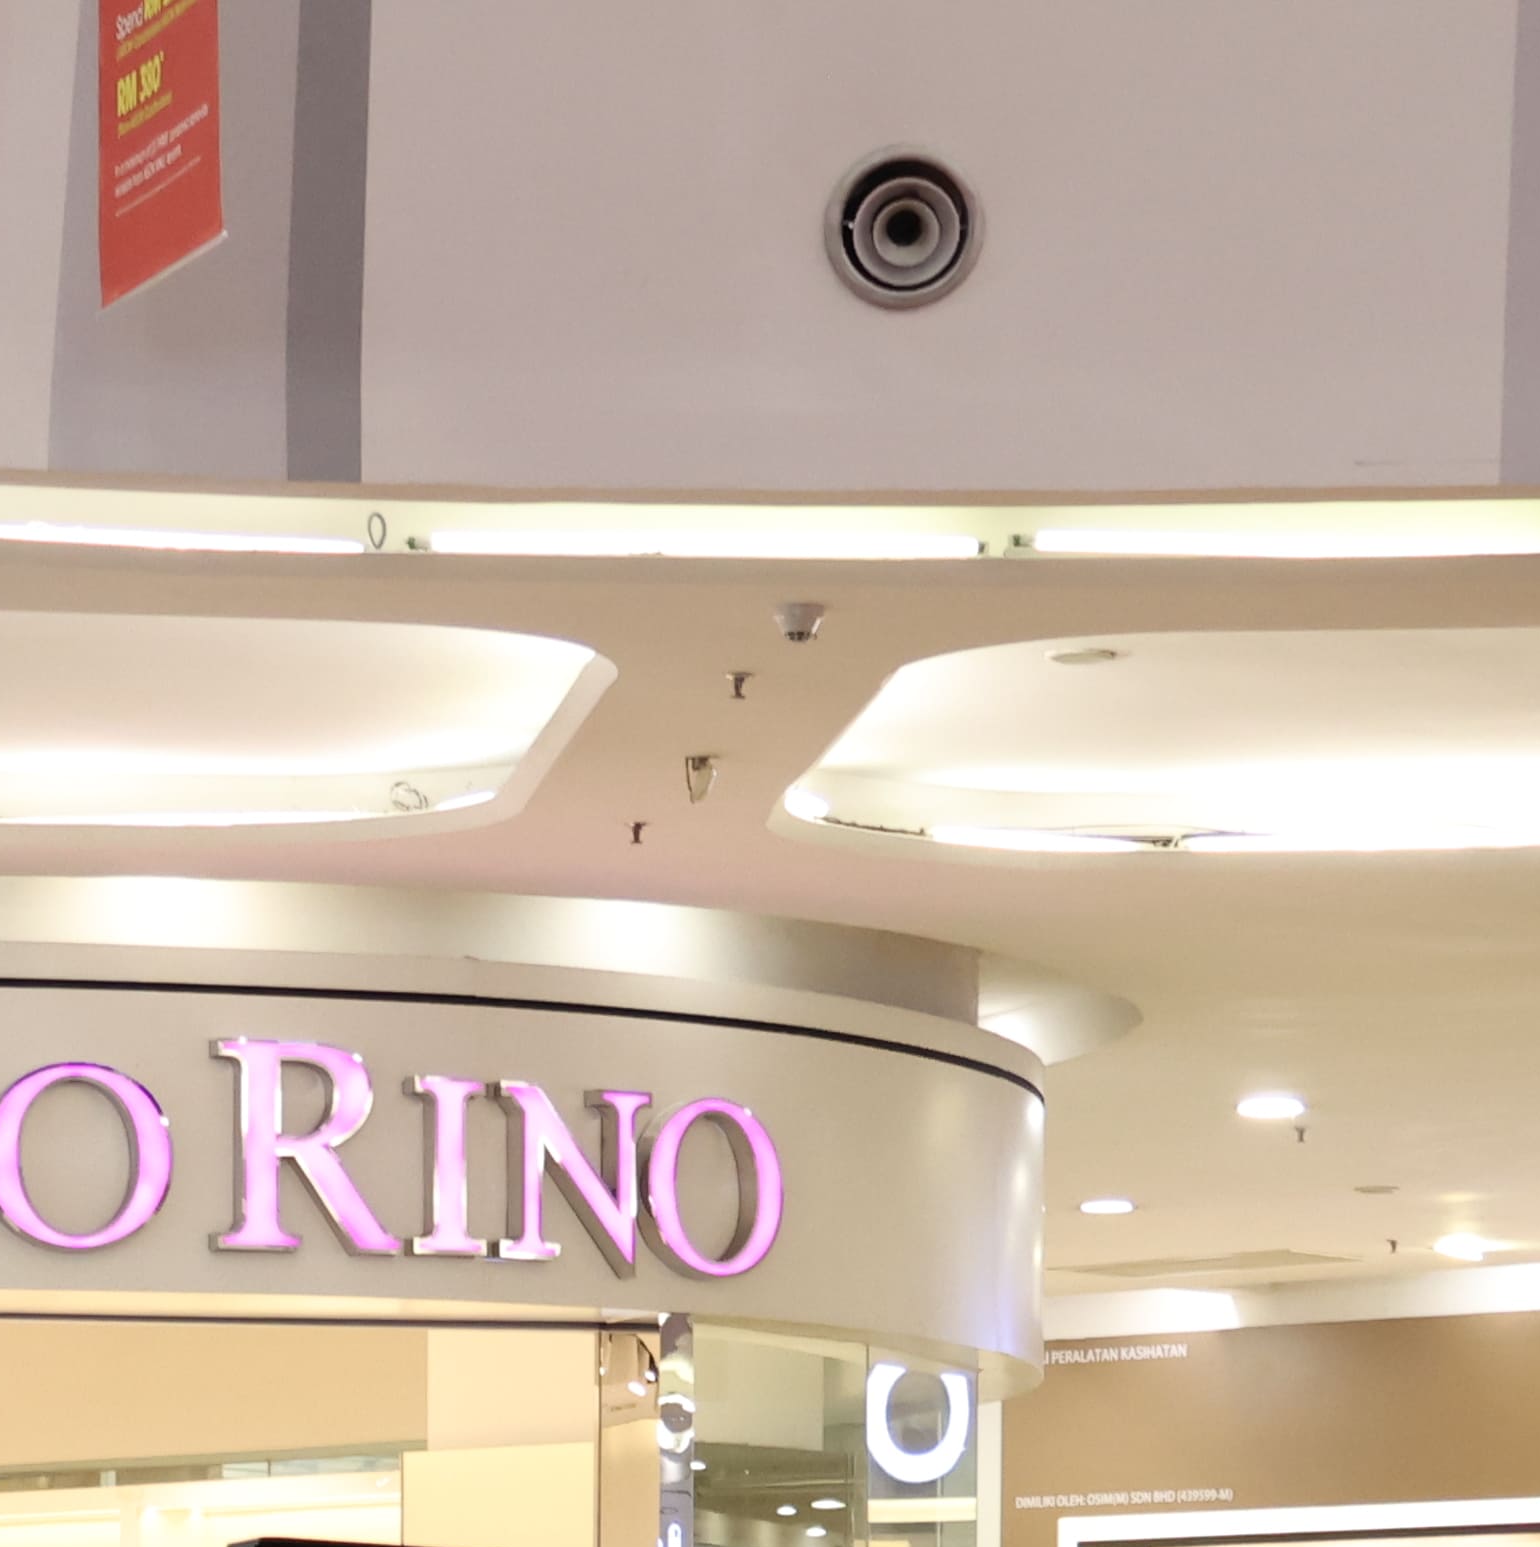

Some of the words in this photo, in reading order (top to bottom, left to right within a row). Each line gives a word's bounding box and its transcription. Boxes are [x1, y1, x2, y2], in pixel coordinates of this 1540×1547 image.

[208, 1038, 783, 1278] RINO
[1050, 1349, 1118, 1365] PERALATAN
[1131, 1491, 1151, 1505] SDN
[1153, 1490, 1175, 1504] BHD
